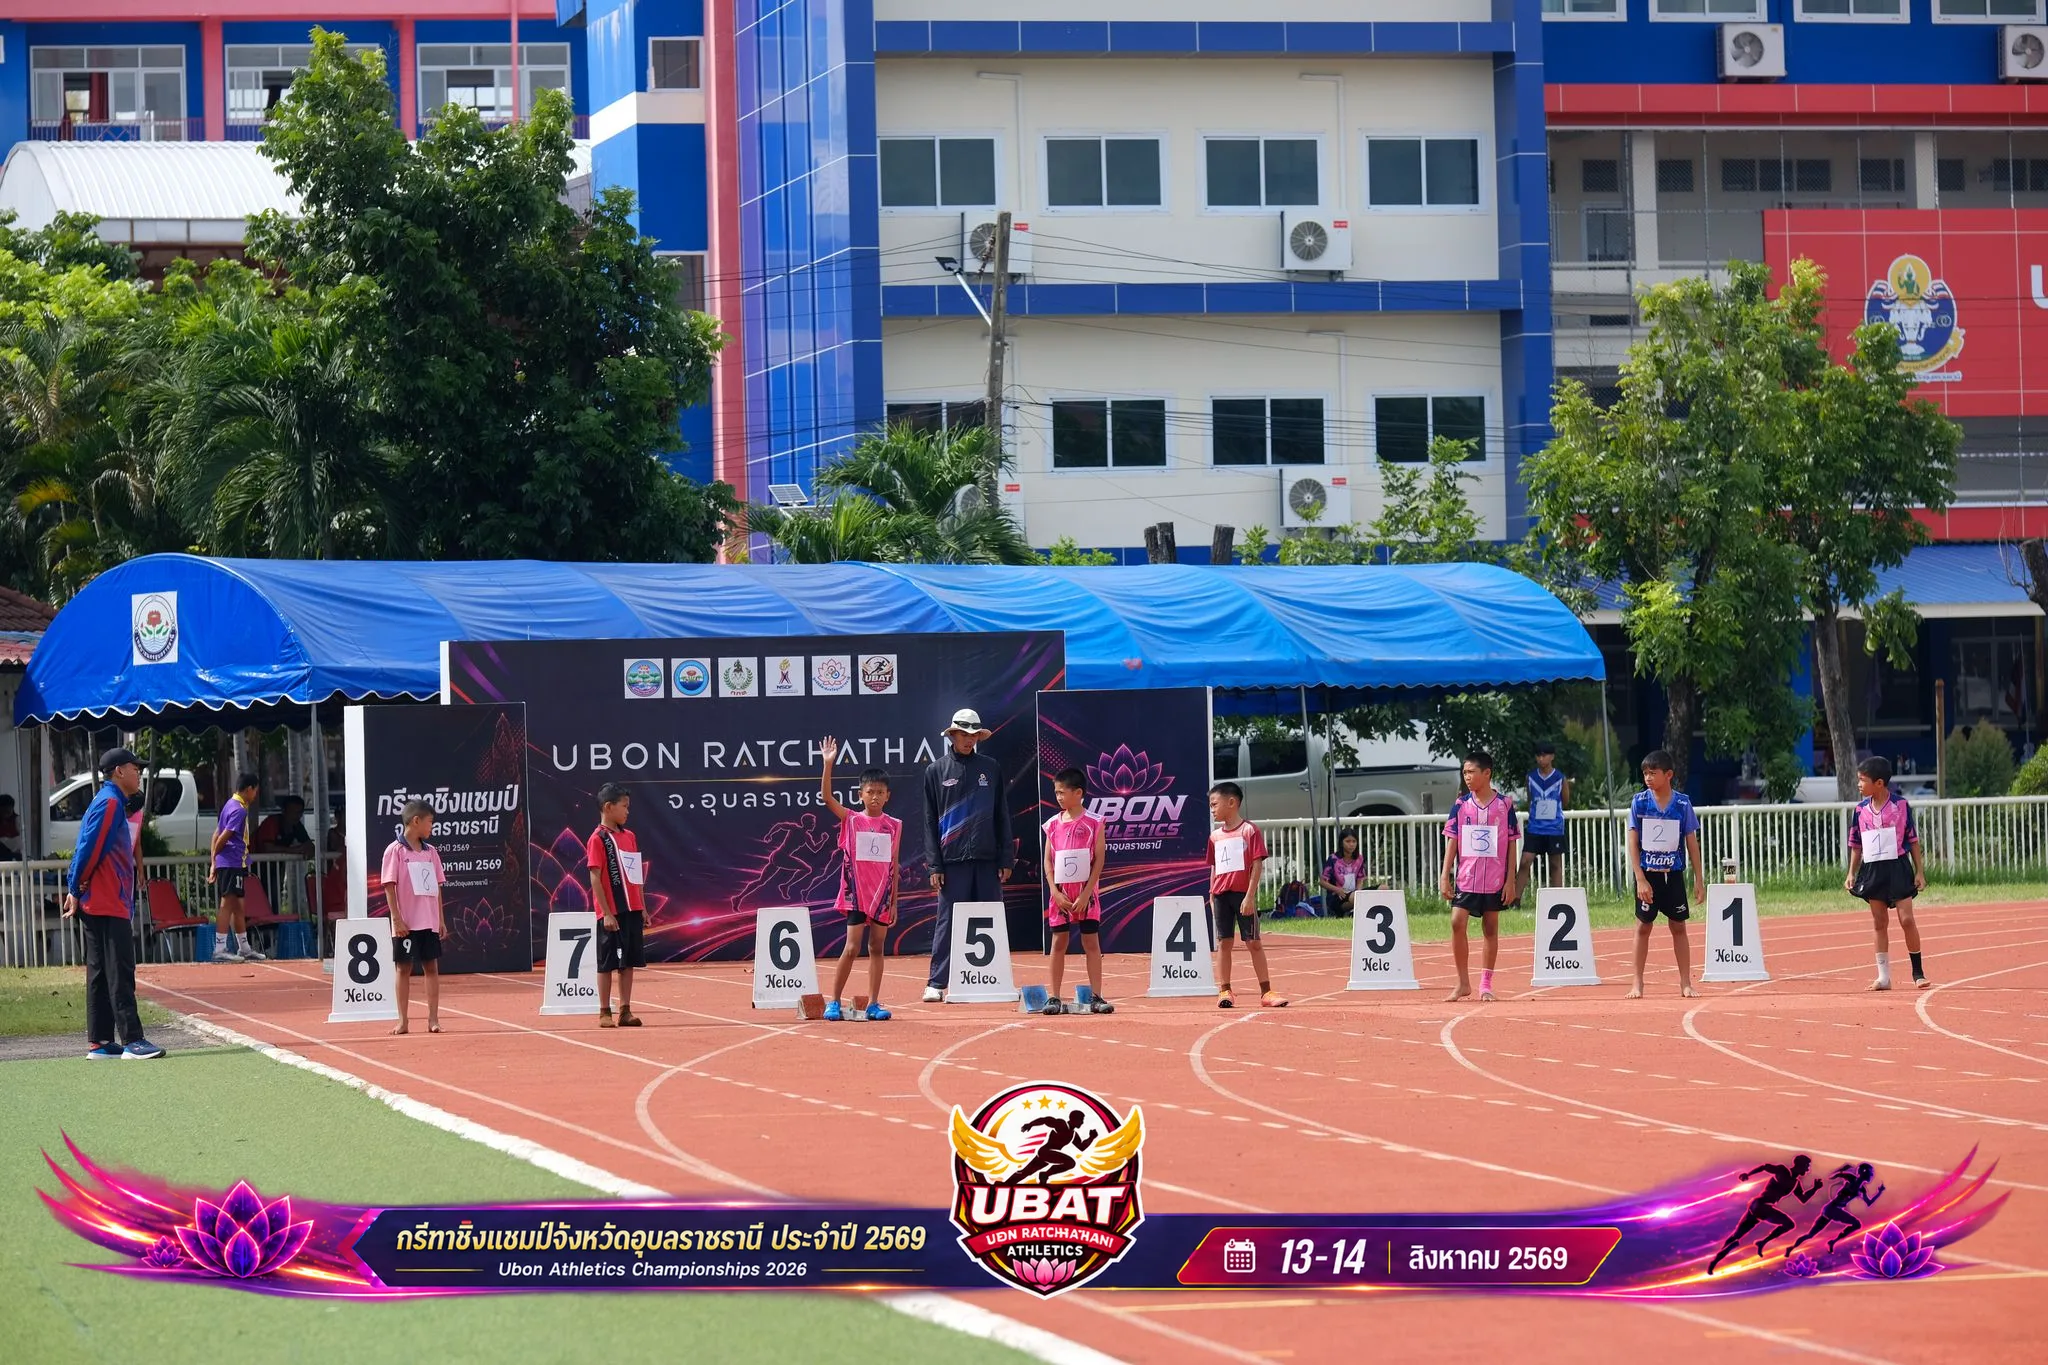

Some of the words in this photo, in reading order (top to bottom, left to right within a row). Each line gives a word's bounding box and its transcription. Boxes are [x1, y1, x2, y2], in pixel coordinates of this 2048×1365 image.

[553, 742, 680, 771] UBON
[1472, 829, 1490, 852] 3
[1652, 825, 1667, 842] 2
[452, 843, 470, 852] 2569
[871, 837, 879, 855] 6
[1872, 833, 1888, 856] 1
[475, 858, 502, 871] 2569
[624, 856, 635, 873] 7
[1221, 846, 1231, 866] 4
[1064, 857, 1078, 878] 5
[422, 869, 430, 891] 8
[1366, 905, 1396, 954] 3
[1547, 904, 1578, 951] 2
[1722, 898, 1743, 946] 1
[403, 939, 412, 953] 9
[769, 920, 801, 971] 6
[965, 917, 995, 967] 5
[1165, 912, 1196, 961] 4
[347, 933, 380, 984] 8
[559, 928, 592, 979] 7
[1545, 956, 1580, 970] Nelco
[1715, 949, 1749, 963] Nelco
[765, 975, 802, 989] Nelco
[960, 971, 997, 985] Nelco
[1162, 965, 1198, 979] Nelco
[344, 989, 383, 1003] Nelco
[556, 983, 594, 997] Nelco
